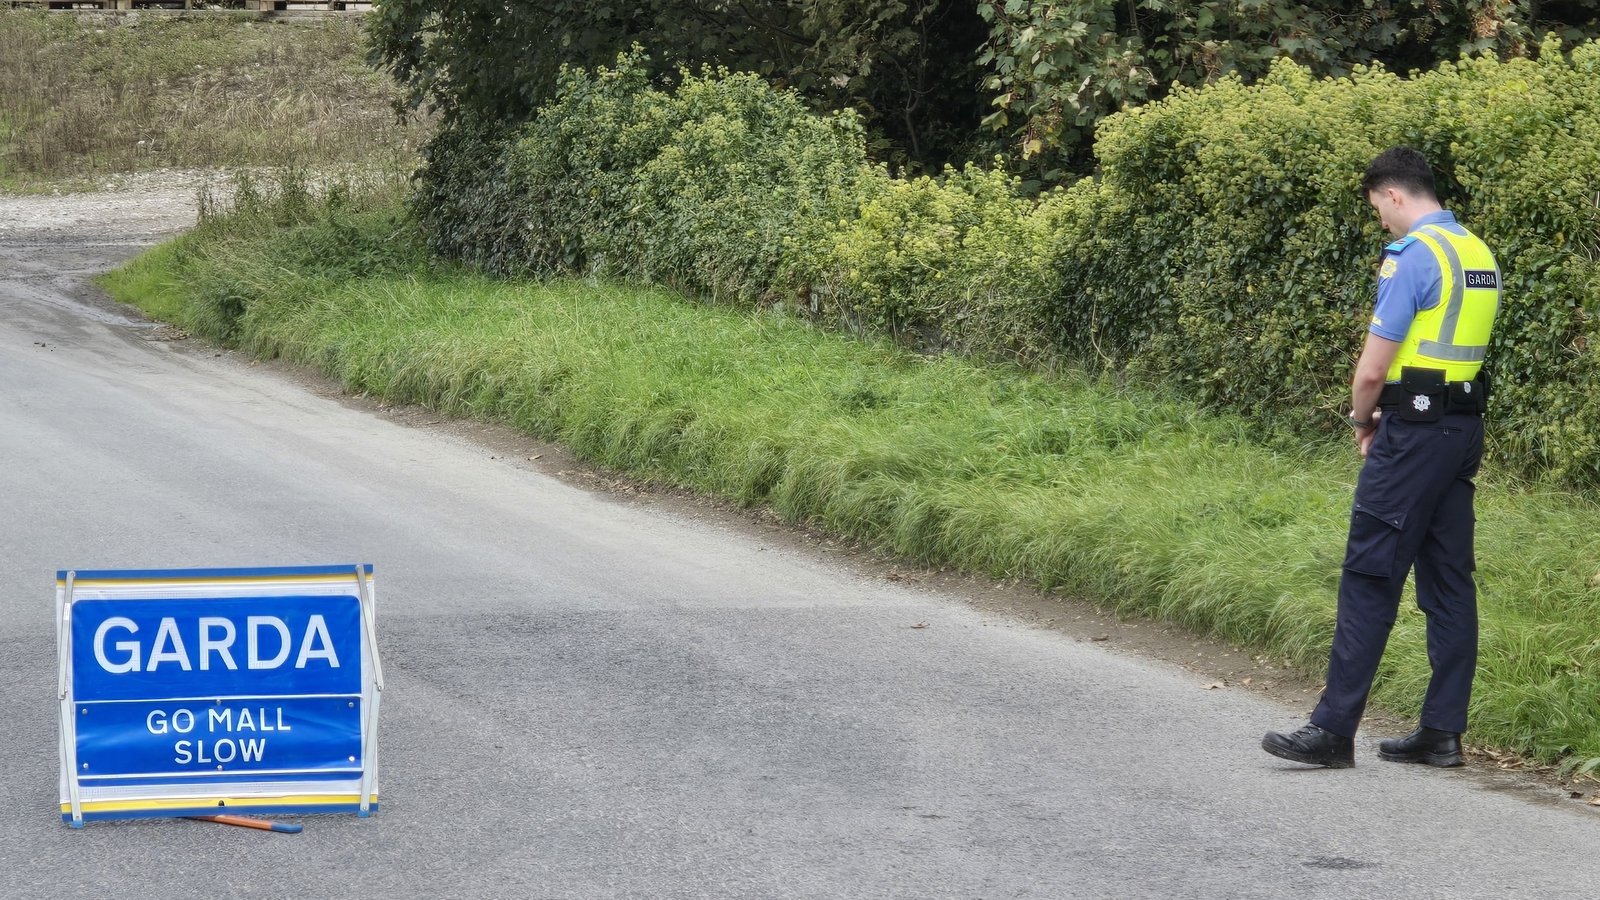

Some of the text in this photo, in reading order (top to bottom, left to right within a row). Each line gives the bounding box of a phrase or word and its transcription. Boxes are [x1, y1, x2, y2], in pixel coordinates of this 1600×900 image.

[1468, 274, 1495, 285] GARDA
[93, 615, 340, 673] GARDA
[146, 707, 291, 735] GO MALL
[174, 738, 266, 764] SLOW
